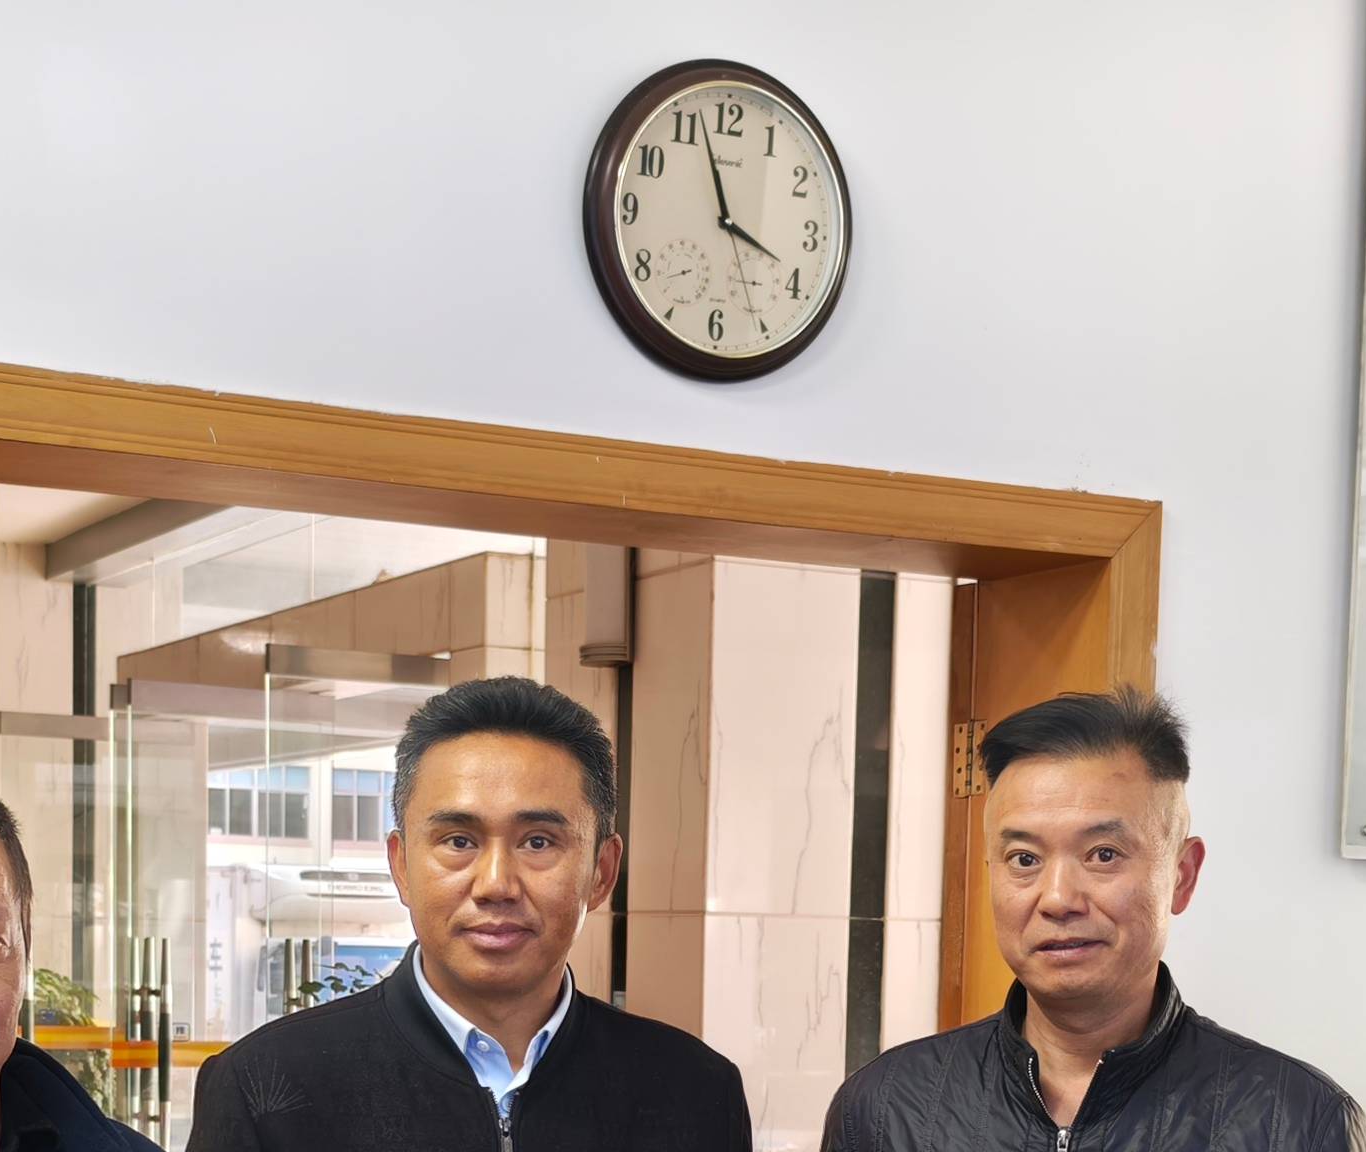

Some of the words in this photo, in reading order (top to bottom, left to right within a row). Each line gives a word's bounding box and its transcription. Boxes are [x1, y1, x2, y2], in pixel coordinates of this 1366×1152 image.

[670, 109, 699, 146] 11
[713, 101, 745, 138] 12
[763, 125, 777, 157] 1
[637, 144, 664, 179] 10
[792, 166, 808, 198] 2
[622, 192, 639, 225] 9
[802, 220, 819, 252] 3
[634, 248, 651, 282] 8
[785, 267, 801, 300] 4
[708, 308, 724, 341] 6
